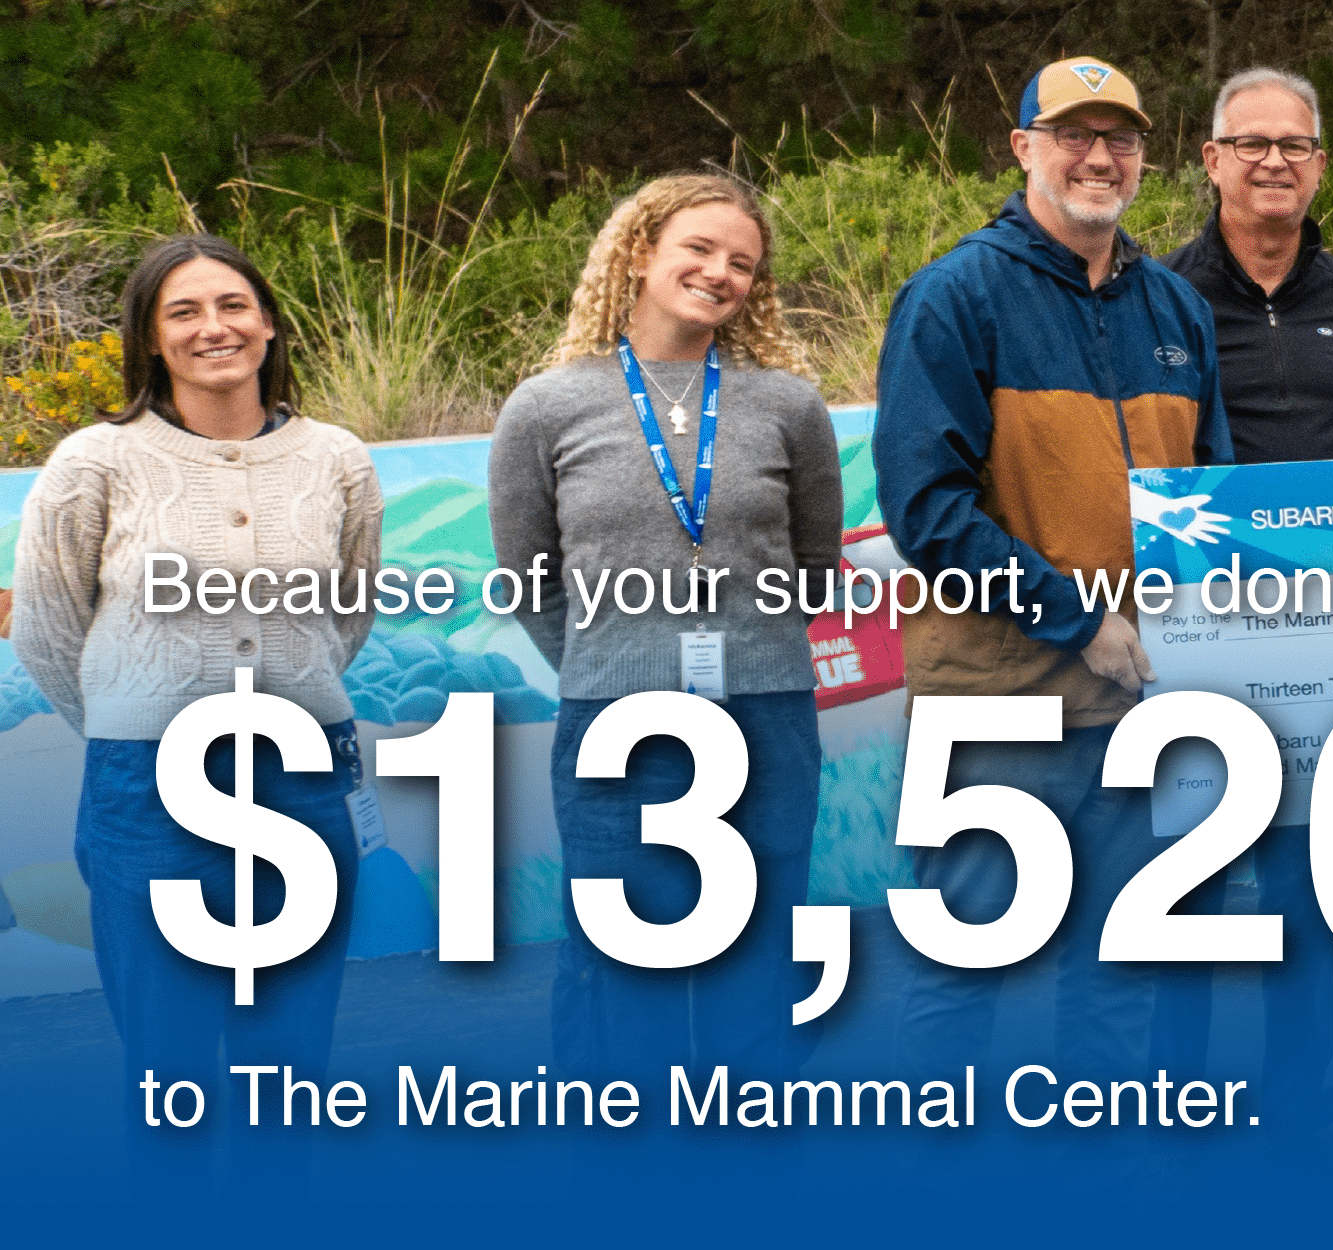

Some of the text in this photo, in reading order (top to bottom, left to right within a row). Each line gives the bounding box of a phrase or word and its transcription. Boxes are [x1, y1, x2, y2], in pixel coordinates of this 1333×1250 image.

[1162, 612, 1231, 628] Pay to the
[1242, 615, 1279, 631] The
[1163, 629, 1220, 644] Order of
[1245, 679, 1324, 700] Thirteen
[1277, 734, 1322, 750] baru
[1177, 777, 1213, 790] From
